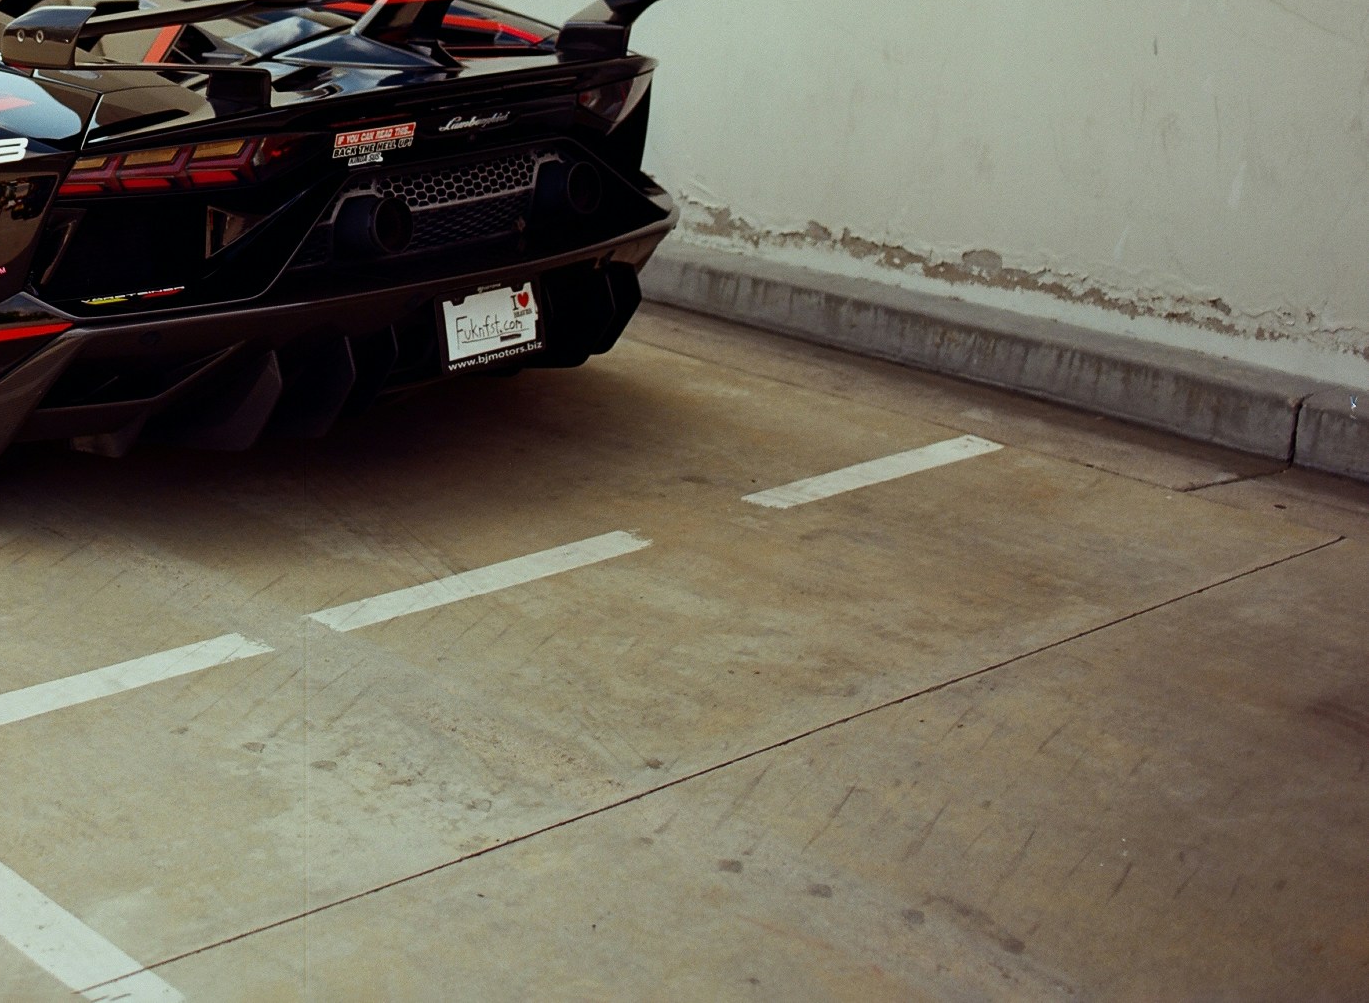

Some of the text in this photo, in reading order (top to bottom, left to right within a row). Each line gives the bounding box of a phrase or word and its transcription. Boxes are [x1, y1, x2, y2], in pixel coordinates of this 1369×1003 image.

[346, 133, 360, 144] YOU
[332, 145, 357, 158] BACK
[358, 143, 376, 155] THE
[510, 294, 520, 311] I
[448, 340, 543, 371] www.bjmotors.biz
